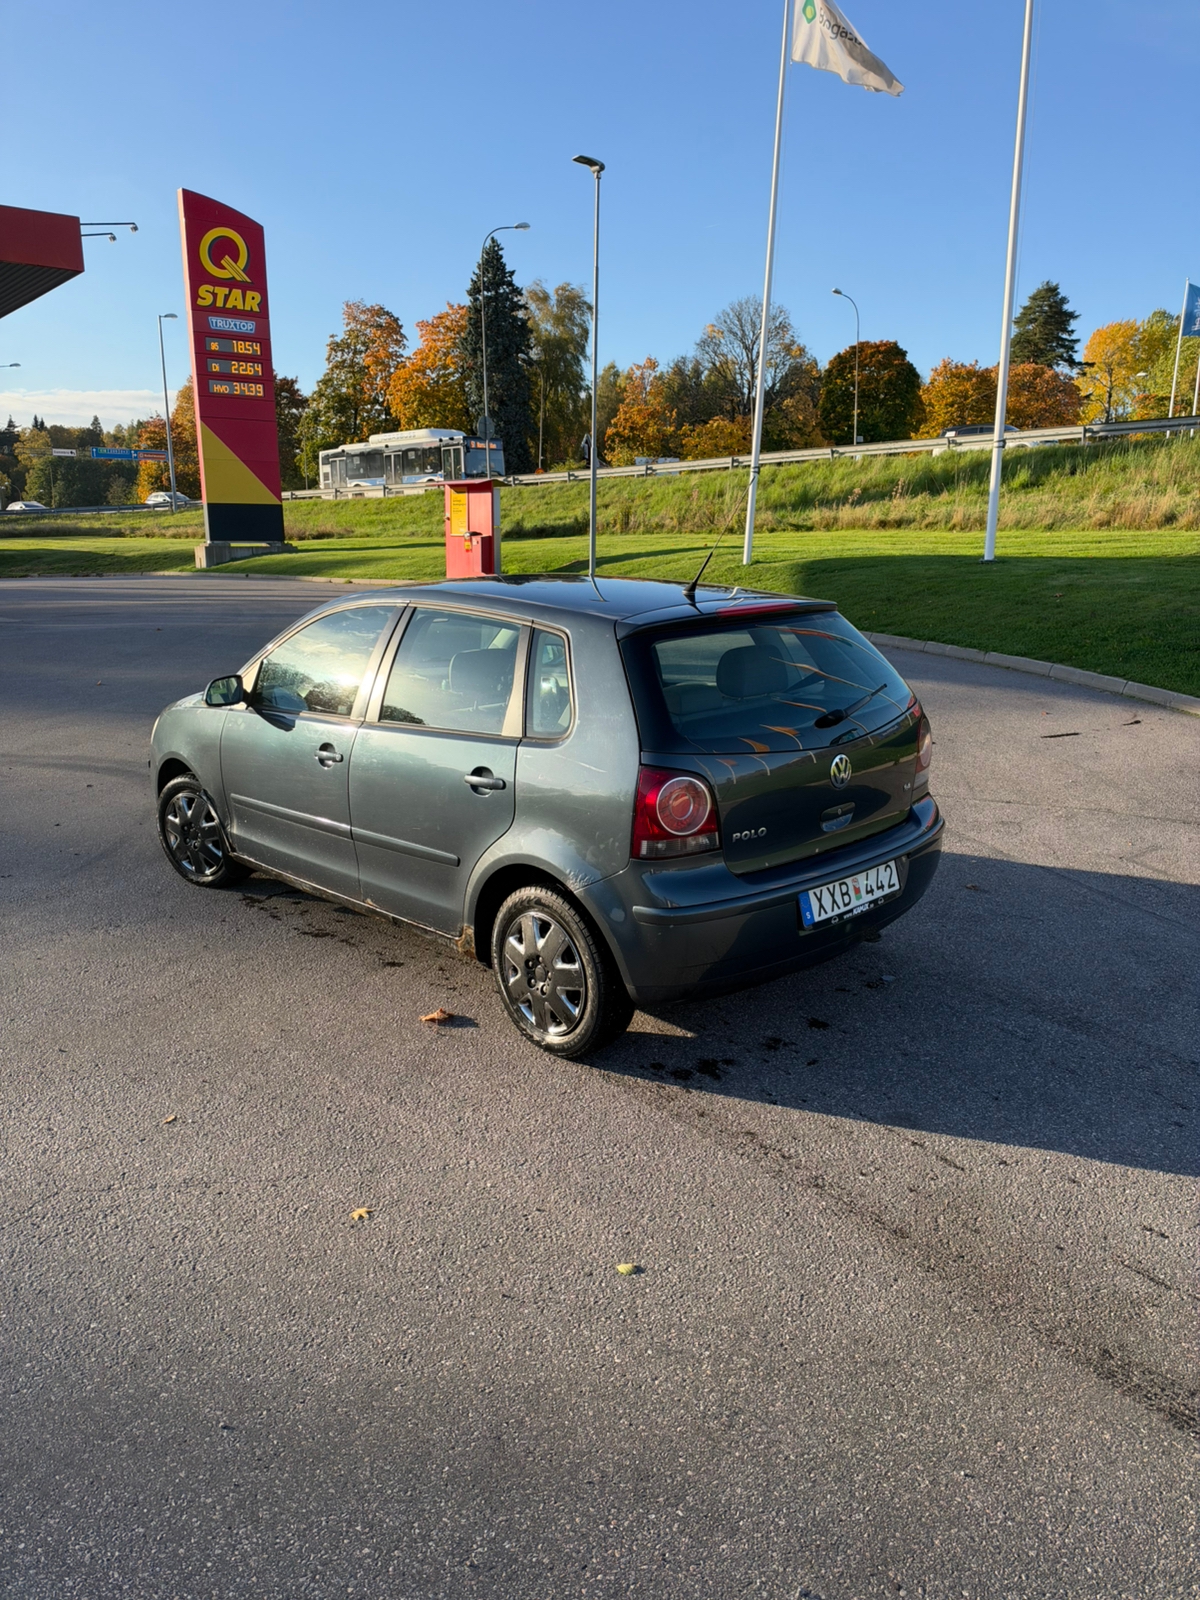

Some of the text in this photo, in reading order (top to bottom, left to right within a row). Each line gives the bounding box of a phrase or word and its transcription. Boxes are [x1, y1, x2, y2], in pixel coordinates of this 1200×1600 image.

[199, 226, 252, 284] Q
[196, 284, 262, 313] STAR
[211, 318, 253, 331] TRUXTOP
[213, 384, 230, 394] HVO
[732, 827, 767, 843] POLO
[813, 865, 896, 918] XXB 442
[805, 911, 812, 920] S
